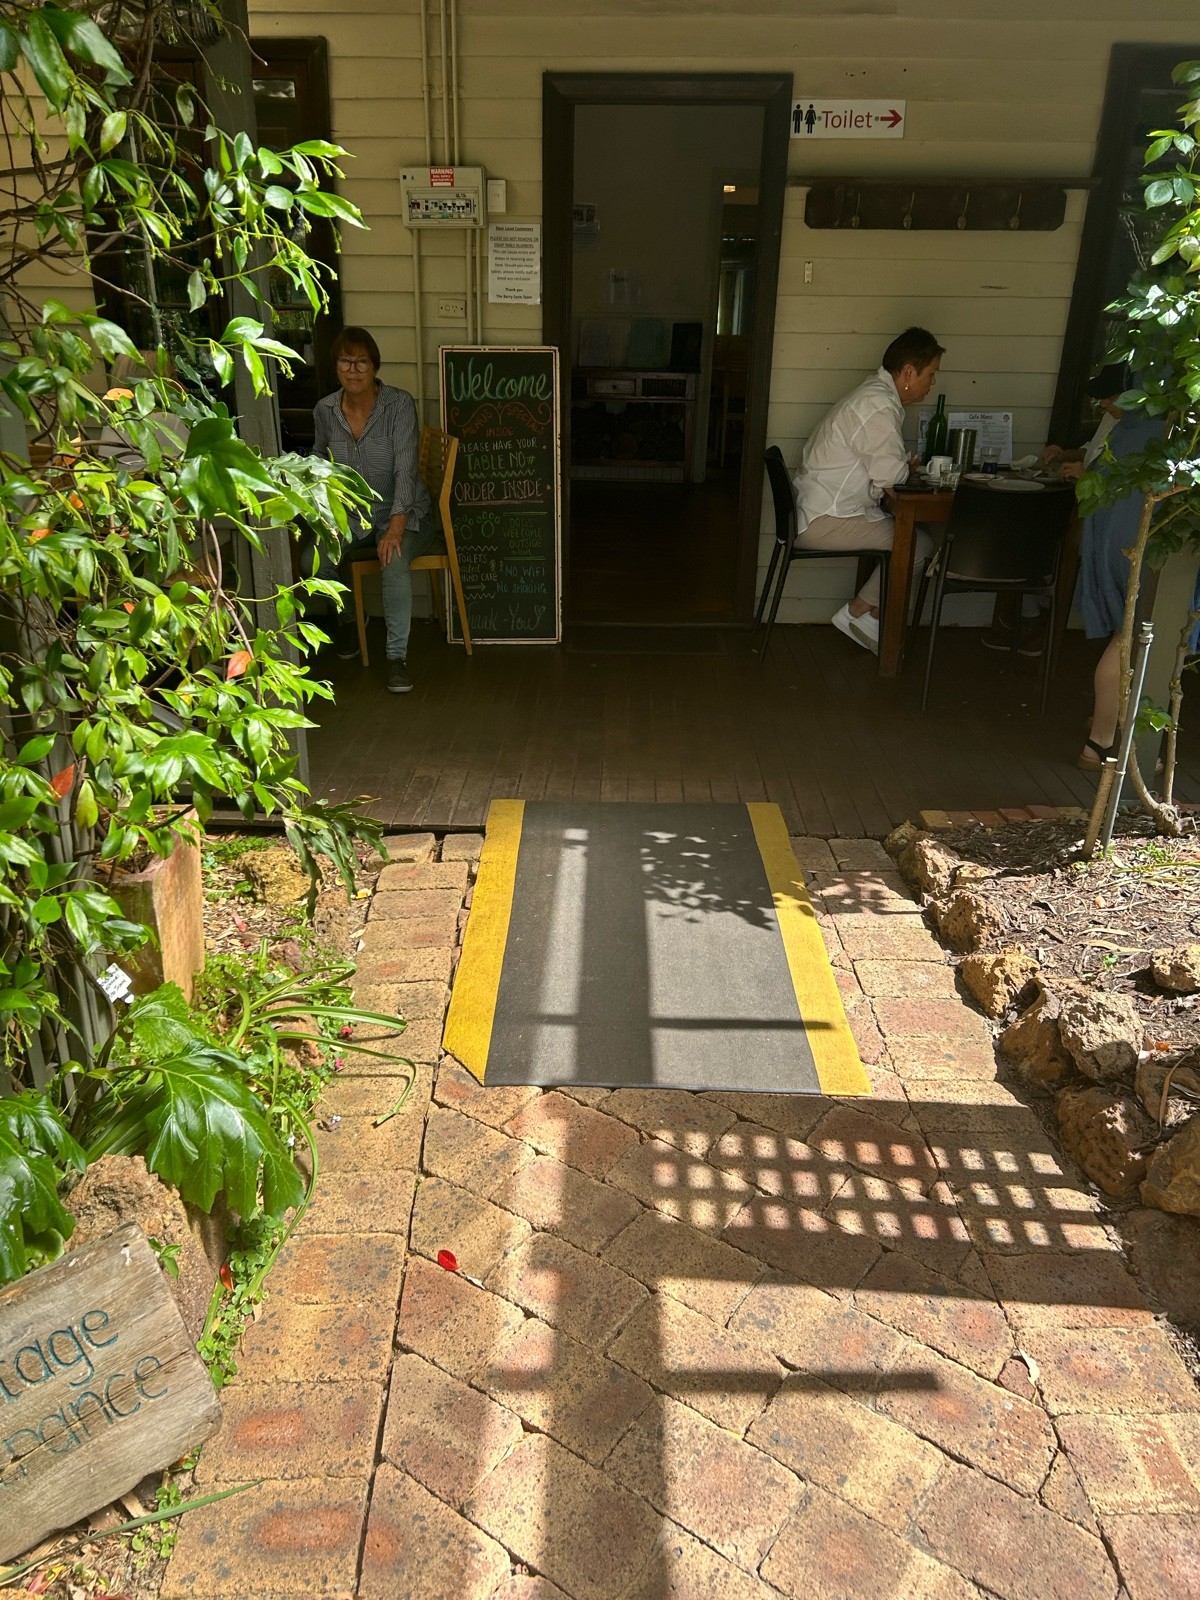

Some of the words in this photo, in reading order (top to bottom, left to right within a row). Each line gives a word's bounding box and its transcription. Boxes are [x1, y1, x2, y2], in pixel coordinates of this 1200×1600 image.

[822, 110, 873, 128] Toilet
[448, 357, 552, 401] Welcome
[485, 427, 514, 437] INSIDE
[458, 442, 489, 452] PLEASE
[493, 440, 512, 450] HAVE
[516, 436, 537, 449] YOUR
[465, 453, 505, 471] TABLE
[454, 481, 496, 502] ORDER
[501, 478, 543, 499] INSIDE
[503, 527, 543, 538] WELCOME
[509, 537, 543, 549] OUTSIDE
[458, 552, 487, 564] TOILETS
[461, 564, 480, 574] cated
[505, 565, 517, 576] NO
[522, 562, 545, 577] WIFI
[462, 573, 478, 582] HIND
[480, 571, 498, 582] CAFE
[496, 582, 508, 593] NO
[512, 582, 547, 594] SMOKING
